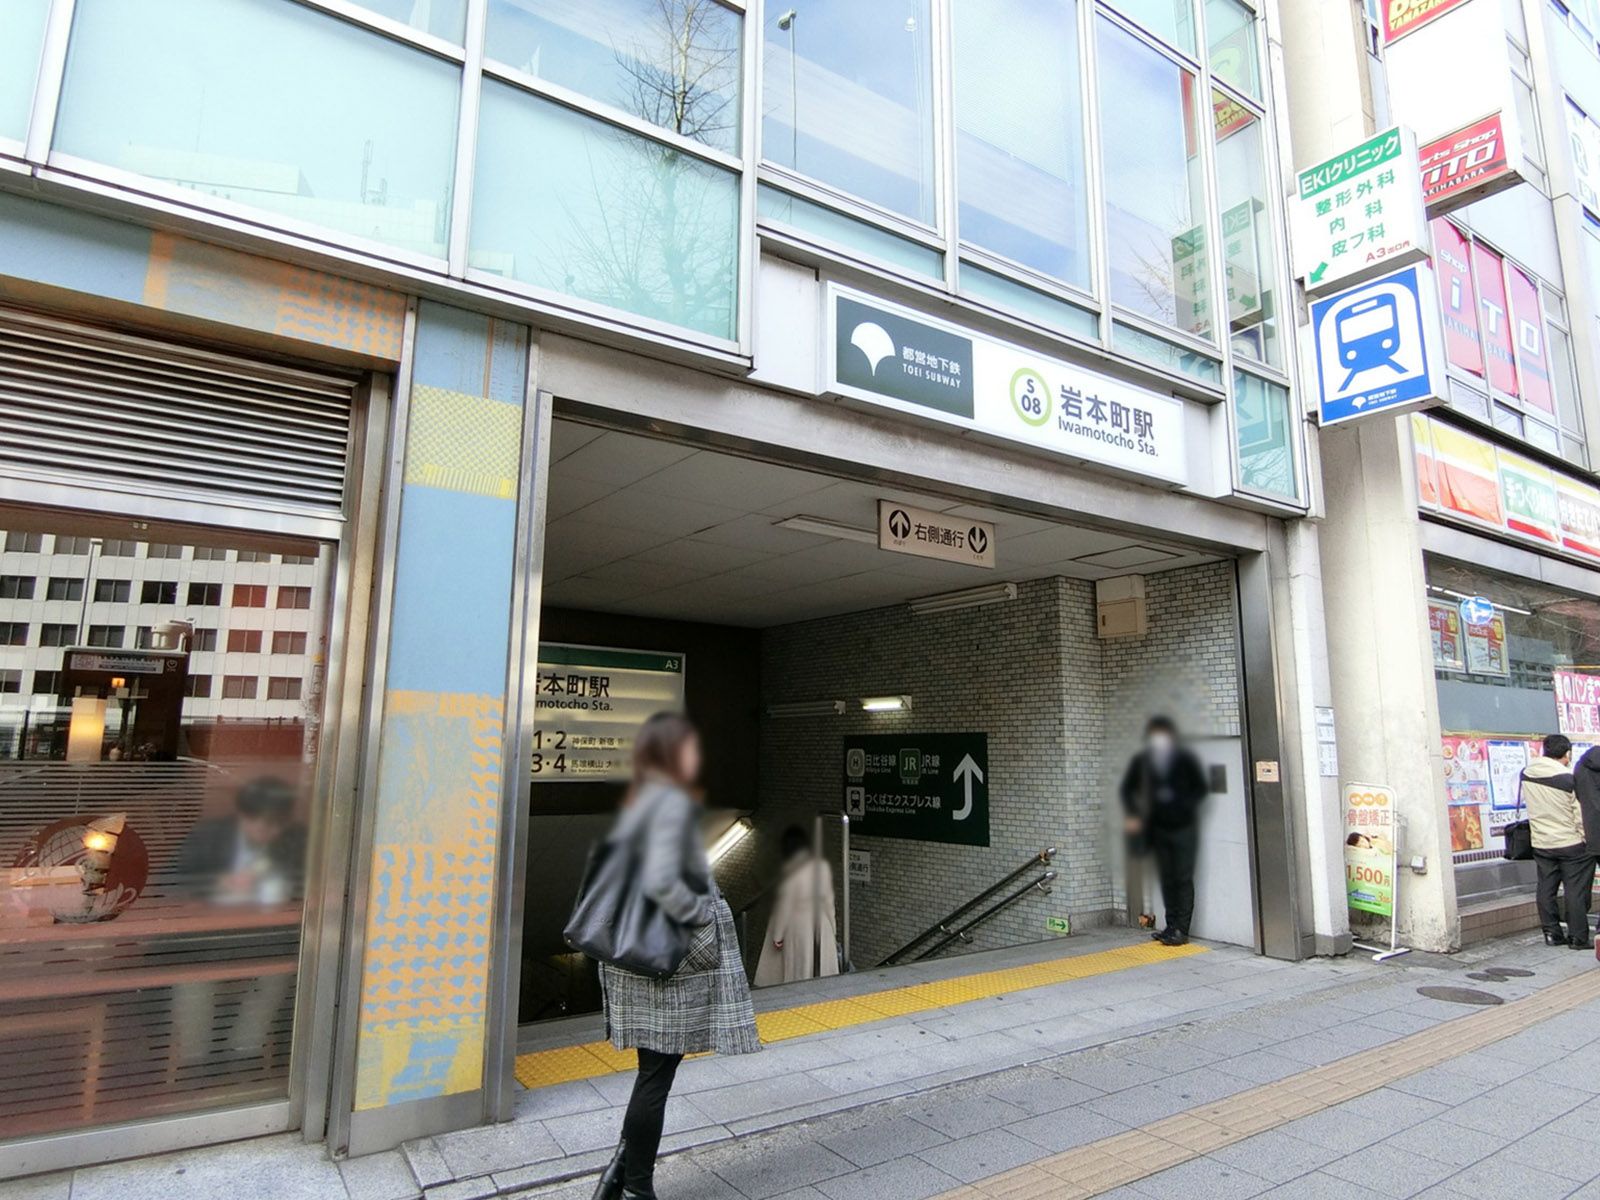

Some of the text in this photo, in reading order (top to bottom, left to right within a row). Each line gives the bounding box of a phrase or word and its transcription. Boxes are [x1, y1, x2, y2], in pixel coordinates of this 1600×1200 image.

[1454, 128, 1497, 152] Shop
[1302, 136, 1399, 195] EKIクリニック
[1316, 168, 1395, 217] 整形外科
[1332, 222, 1385, 257] 皮フ科
[902, 346, 961, 376] 都営地下鉄
[903, 363, 961, 389] TOEI SUBWAY
[1026, 378, 1035, 394] S
[1021, 394, 1042, 415] 08
[1060, 384, 1154, 440] 岩本町駅
[1058, 416, 1159, 457] Iwamotocho Sta.
[914, 523, 964, 548] 右側通行
[665, 660, 679, 670] A3
[592, 701, 613, 711] Sta.
[866, 754, 897, 767] 日比谷線
[904, 757, 917, 771] JR
[921, 754, 940, 768] JR線
[865, 793, 941, 809] つくばエクスプレス線
[1347, 809, 1390, 827] 骨盤矯正
